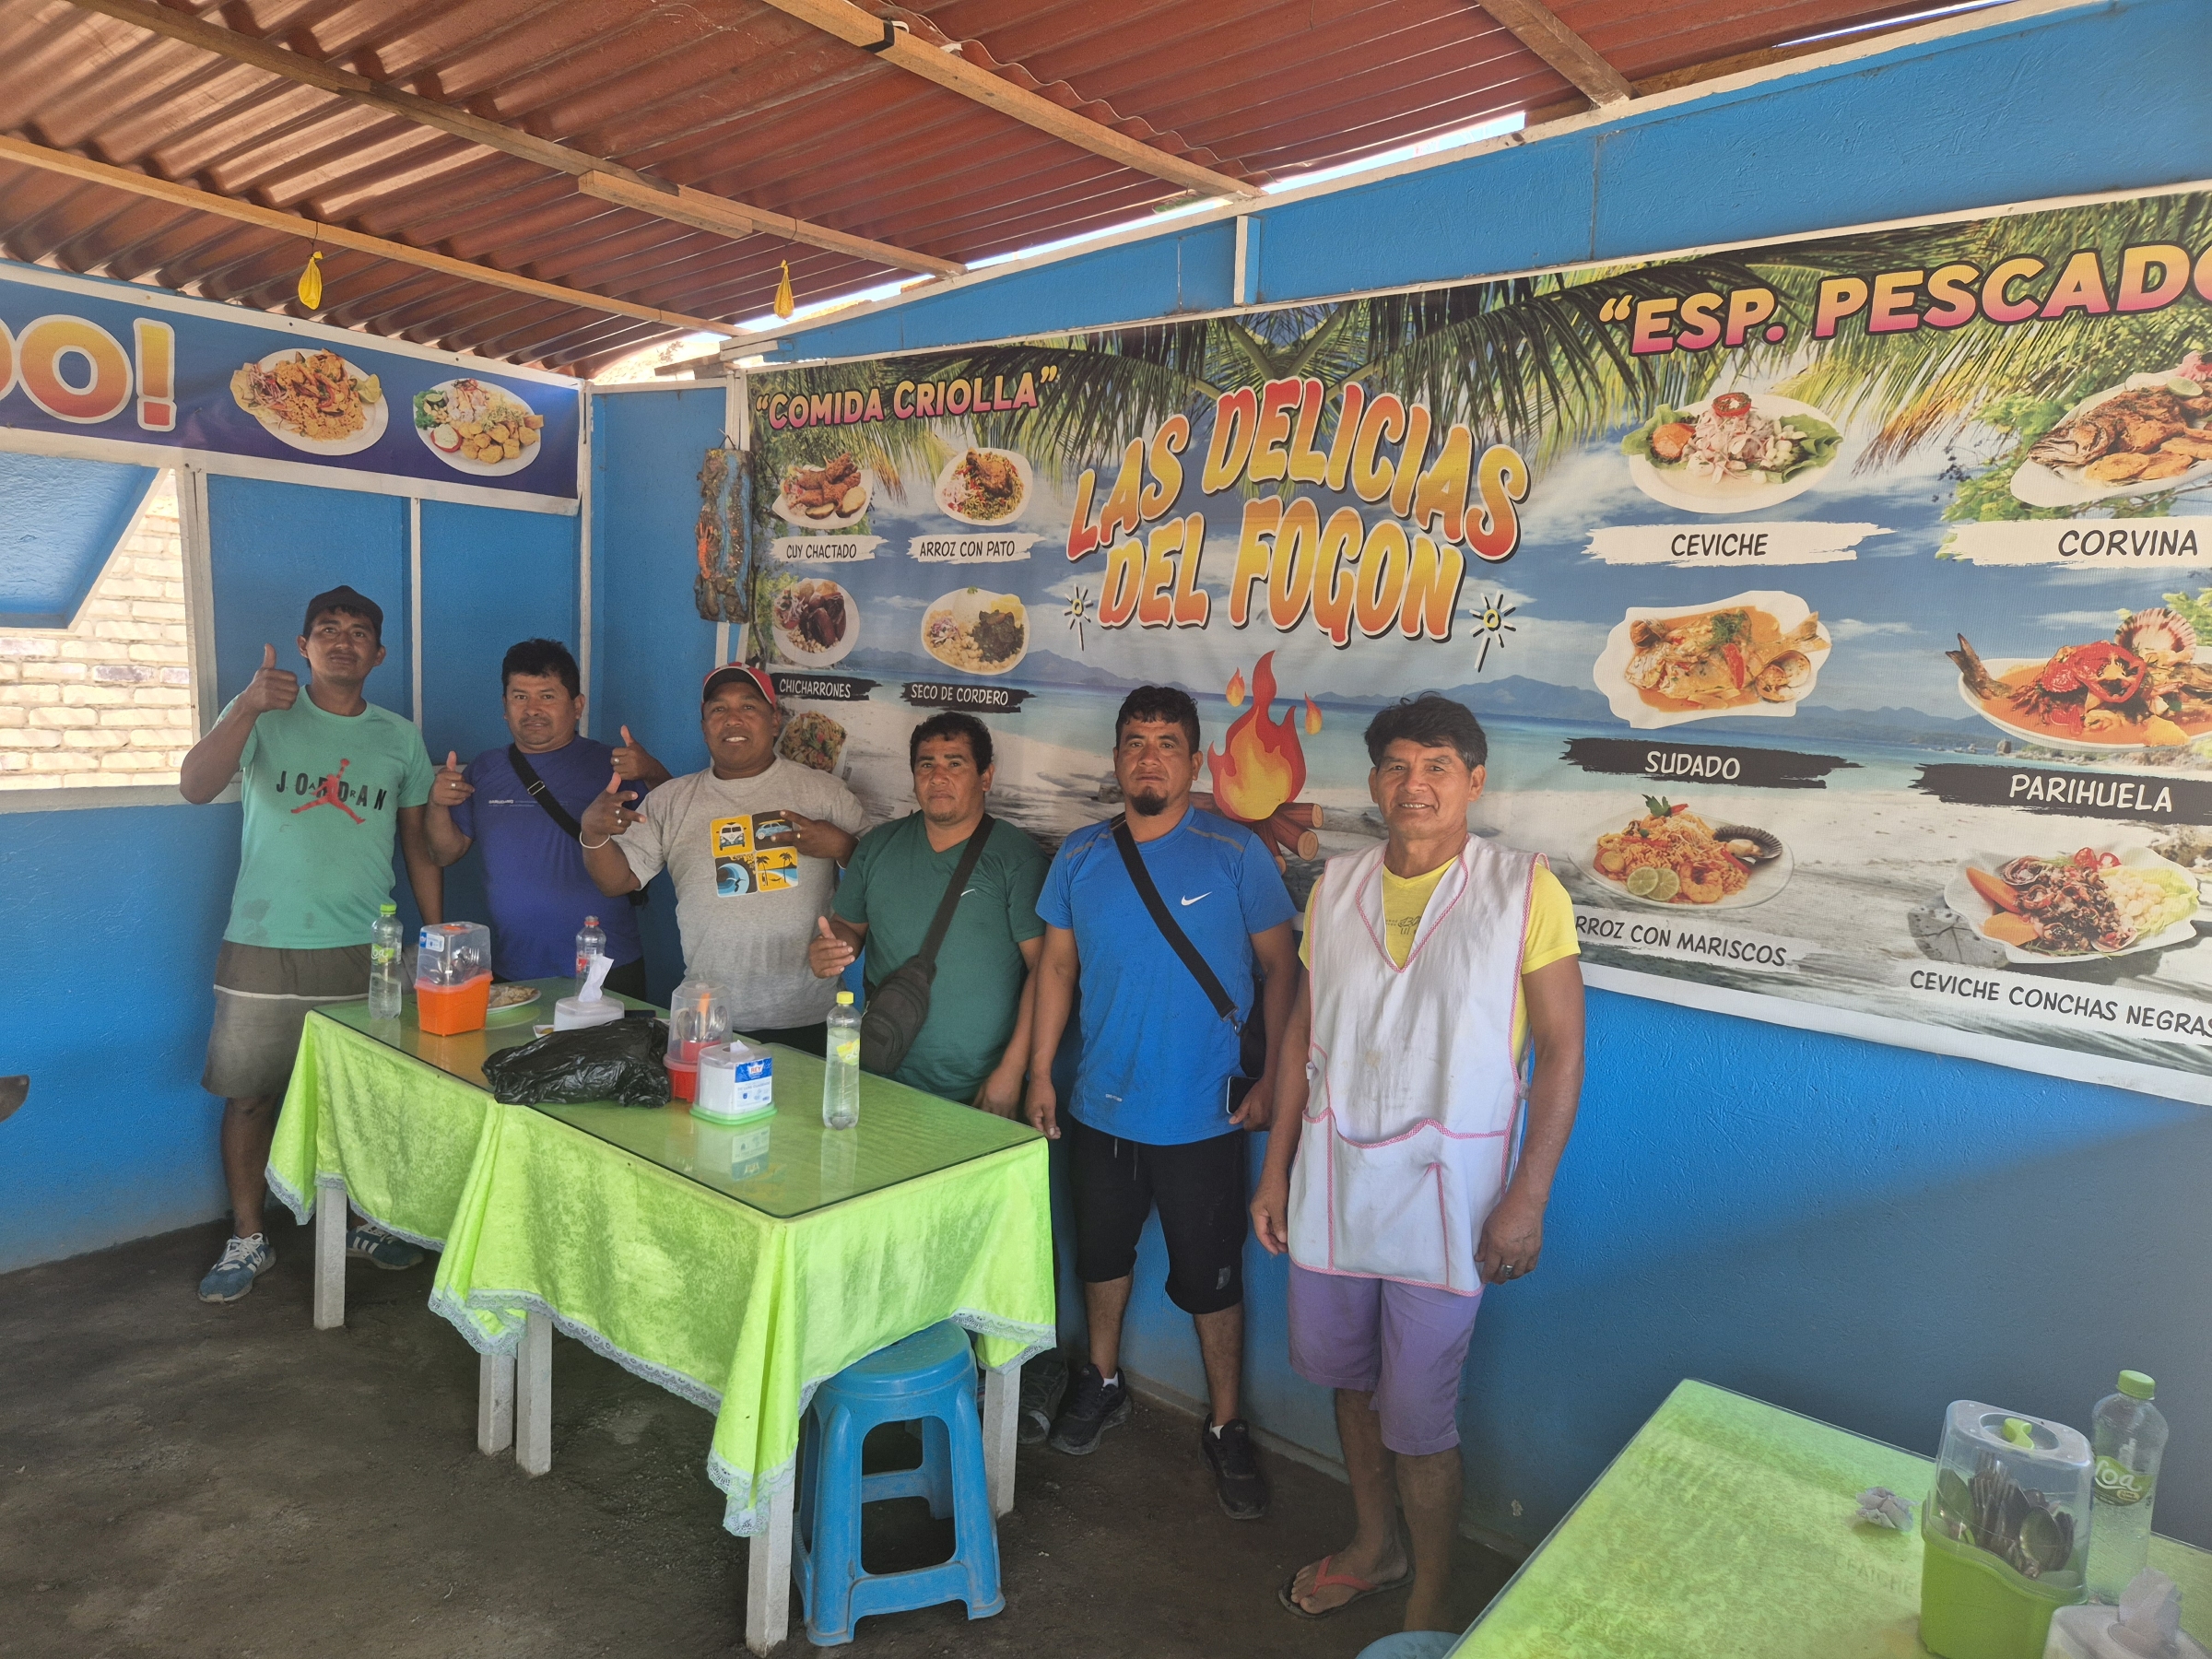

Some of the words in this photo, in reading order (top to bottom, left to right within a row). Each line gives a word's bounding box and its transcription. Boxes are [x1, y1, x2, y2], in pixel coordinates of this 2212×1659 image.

[1812, 241, 2212, 341] PESCAD
[0, 314, 177, 432] O!
[1066, 414, 1190, 561] LAS
[1201, 377, 1530, 561] DELICIAS
[786, 545, 803, 559] CUY
[806, 544, 857, 559] CHACTADO
[920, 542, 956, 558] ARROZ
[959, 542, 984, 558] CON
[986, 540, 1016, 557] PATO
[1671, 533, 1768, 557] CEVICHE
[2058, 529, 2198, 557] CORVINA
[1097, 512, 1210, 628] DEL
[1228, 496, 1465, 647] FOGON
[779, 678, 852, 699] CHICHARRONES
[911, 684, 938, 700] SECO
[940, 686, 953, 700] DE
[957, 688, 1009, 706] CORDERO
[1644, 750, 1741, 781] SUDADO
[2008, 773, 2173, 812] PARIHUELA
[1575, 915, 1625, 939] RROZ
[1630, 924, 1671, 947] CON
[1677, 932, 1787, 967] MARISCOS
[1910, 970, 2000, 1001] CEVICHE
[2008, 986, 2117, 1021] CONCHAS
